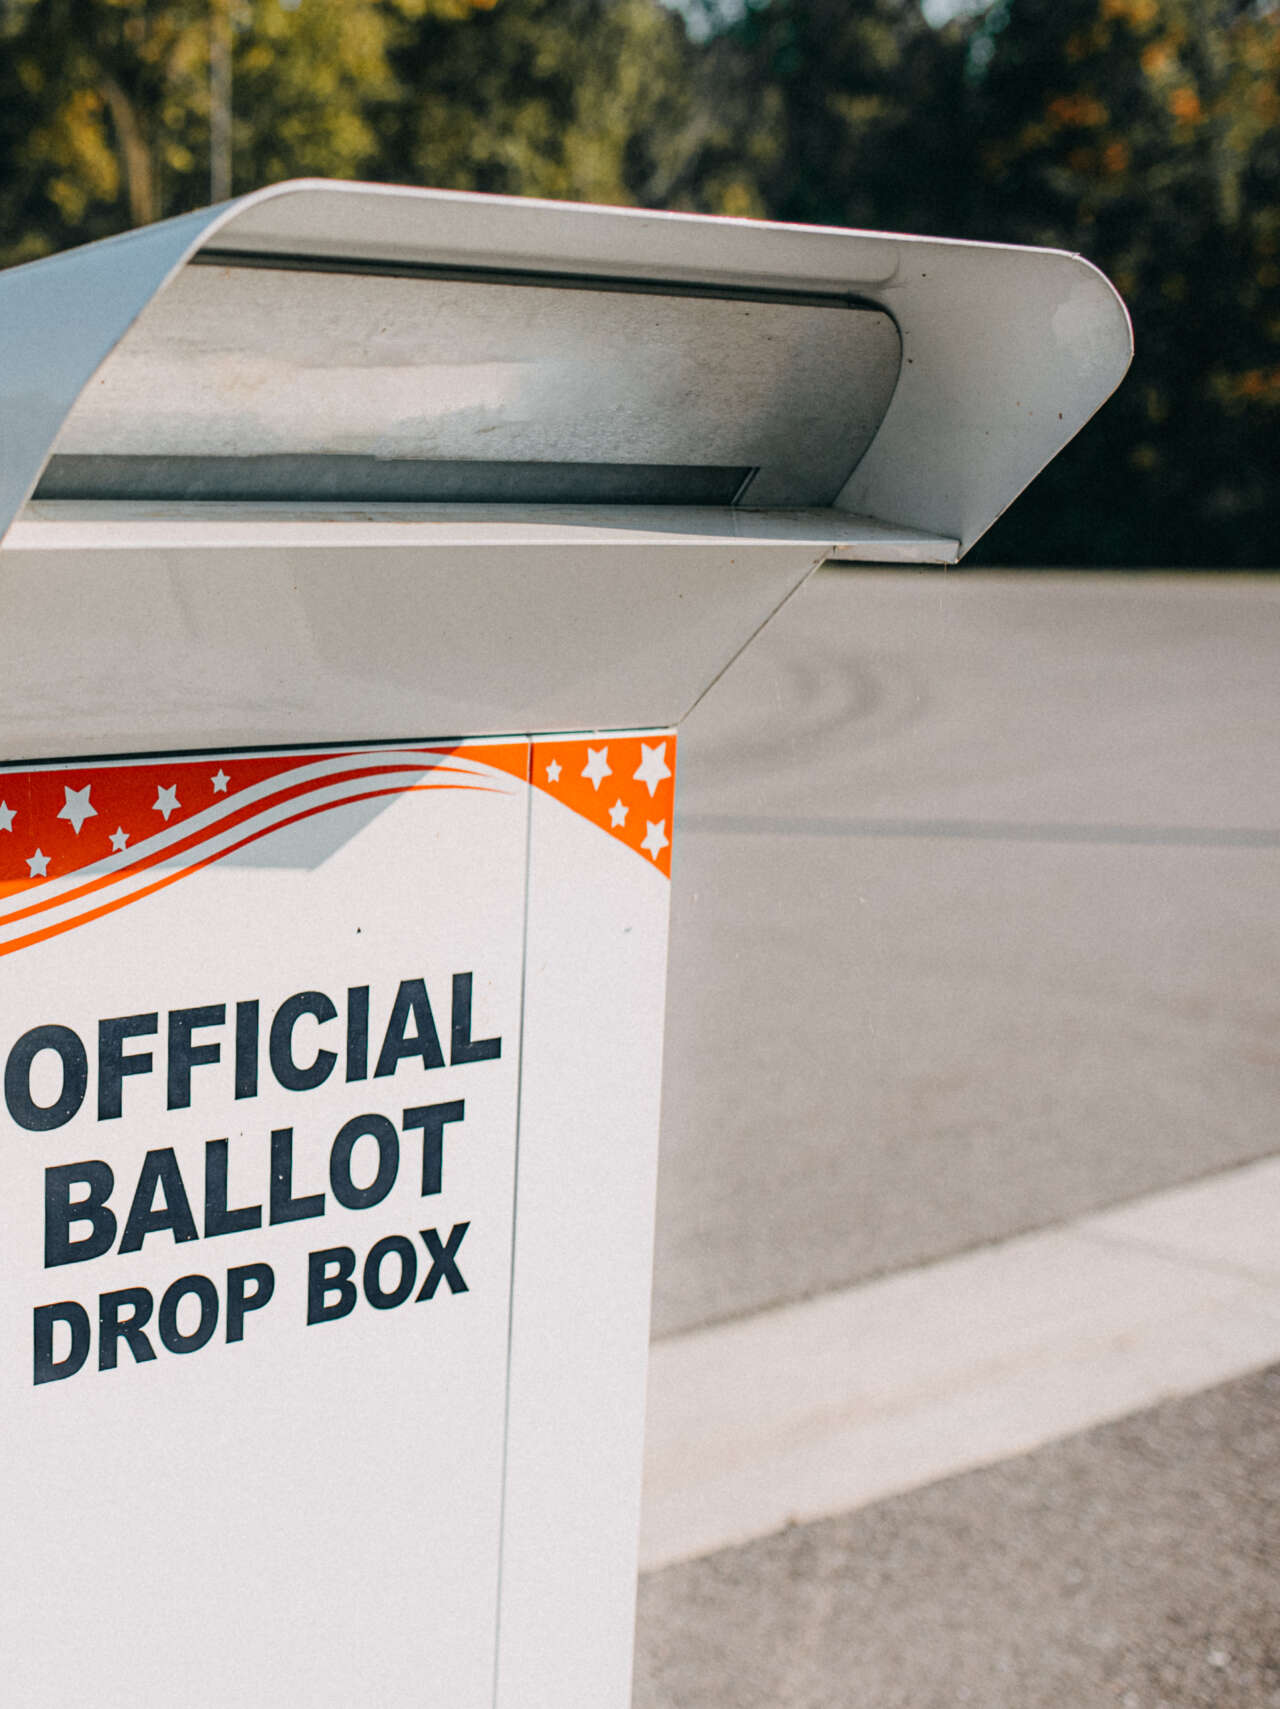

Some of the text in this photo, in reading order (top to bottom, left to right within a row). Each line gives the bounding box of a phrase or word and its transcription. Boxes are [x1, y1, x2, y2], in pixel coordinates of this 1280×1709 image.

[4, 971, 503, 1132] OFFICIAL
[43, 1099, 465, 1269] BALLOT
[33, 1221, 471, 1387] DROP BOX
